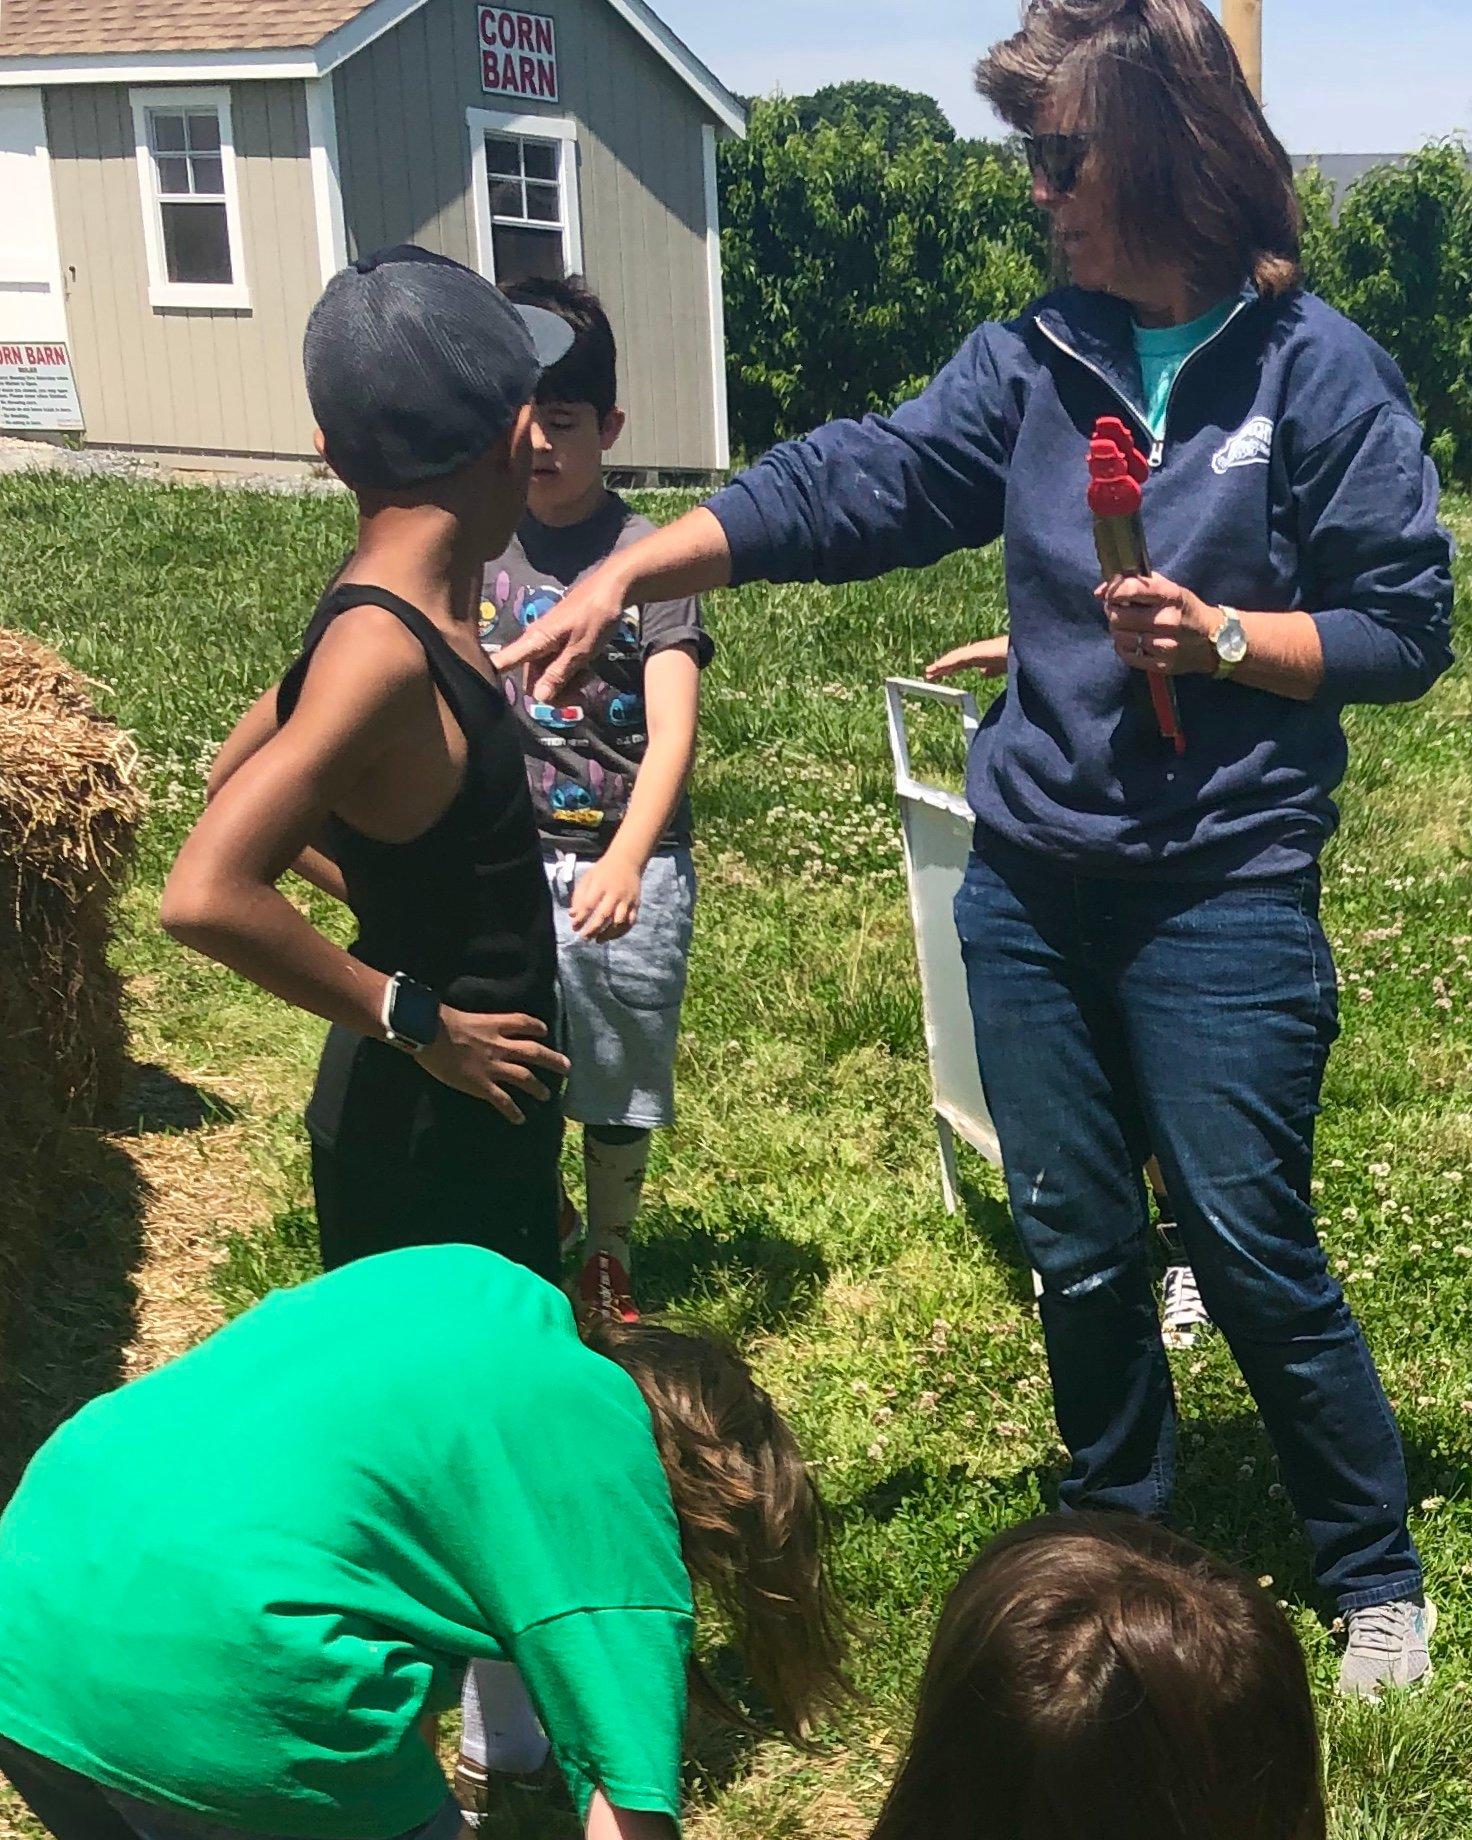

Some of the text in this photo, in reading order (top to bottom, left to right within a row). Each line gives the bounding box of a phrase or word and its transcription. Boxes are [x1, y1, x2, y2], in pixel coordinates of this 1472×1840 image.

[480, 9, 553, 55] CORN
[483, 49, 556, 98] BARN
[25, 346, 66, 366] BARN
